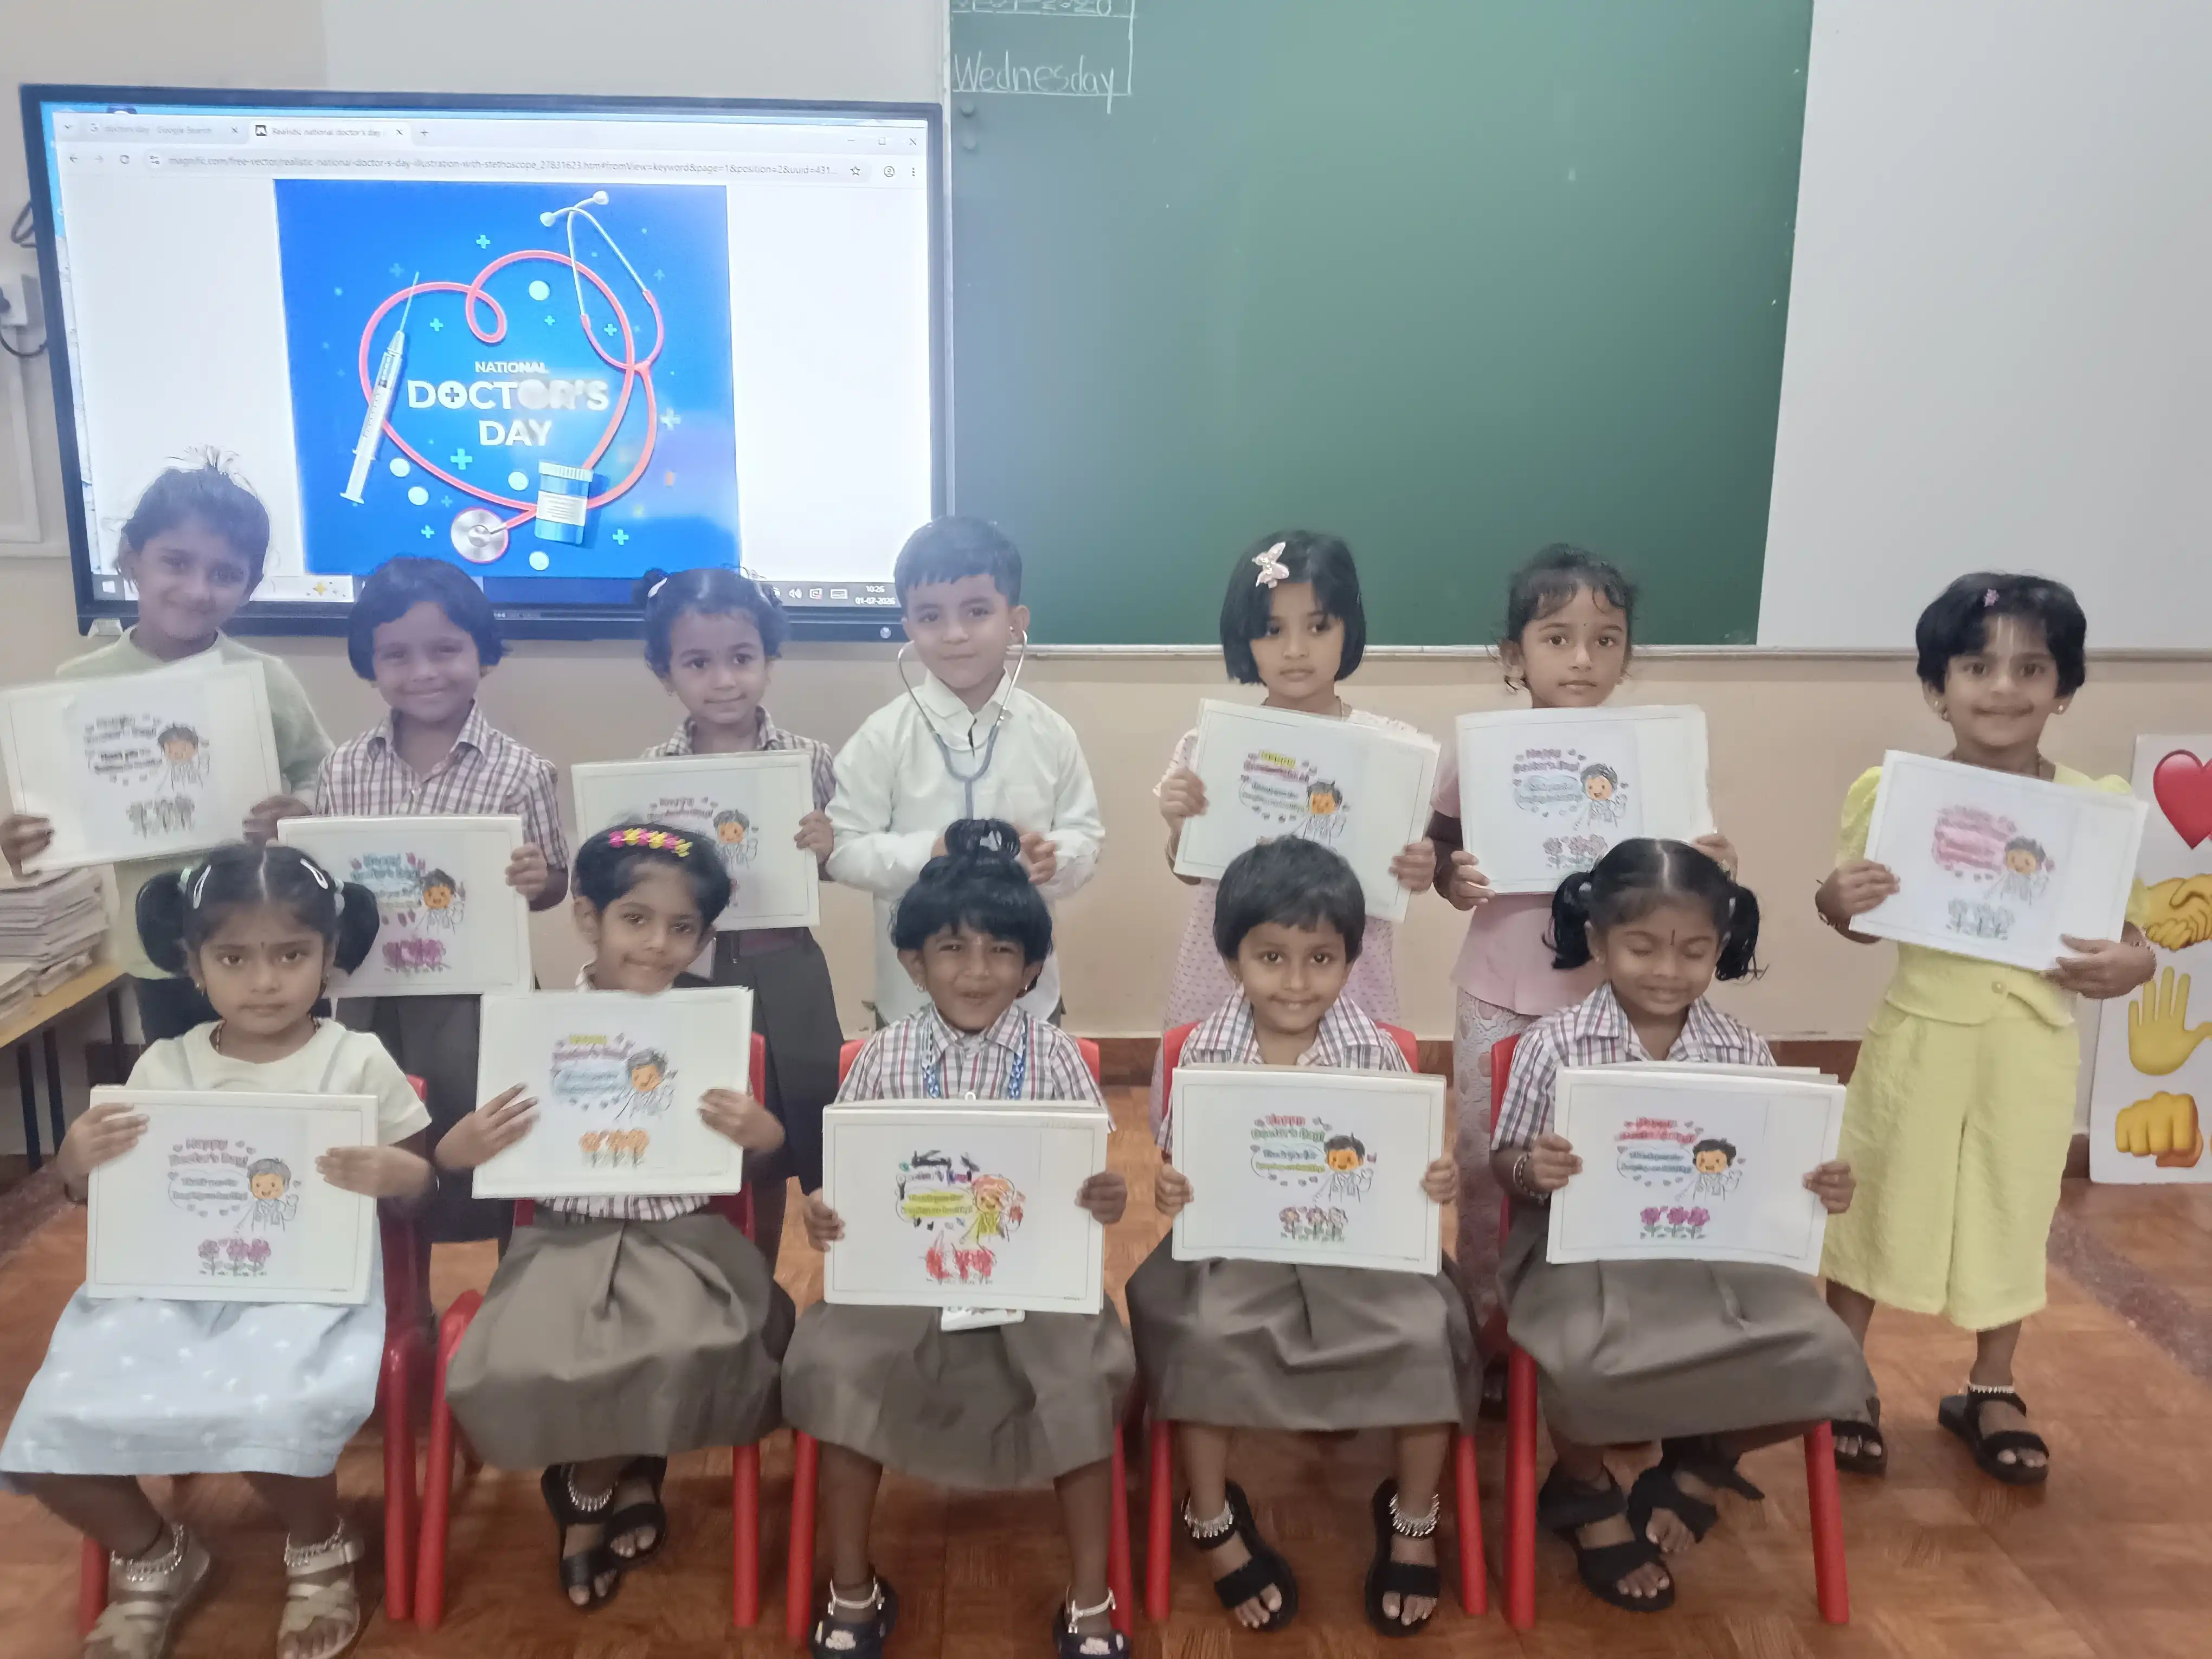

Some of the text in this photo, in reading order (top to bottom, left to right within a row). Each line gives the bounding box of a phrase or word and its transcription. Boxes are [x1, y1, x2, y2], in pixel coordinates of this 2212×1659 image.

[954, 49, 1114, 114] Wednesday
[475, 361, 550, 374] NATIONAL
[407, 378, 609, 411] DOCTOR'S
[479, 419, 553, 446] DAY
